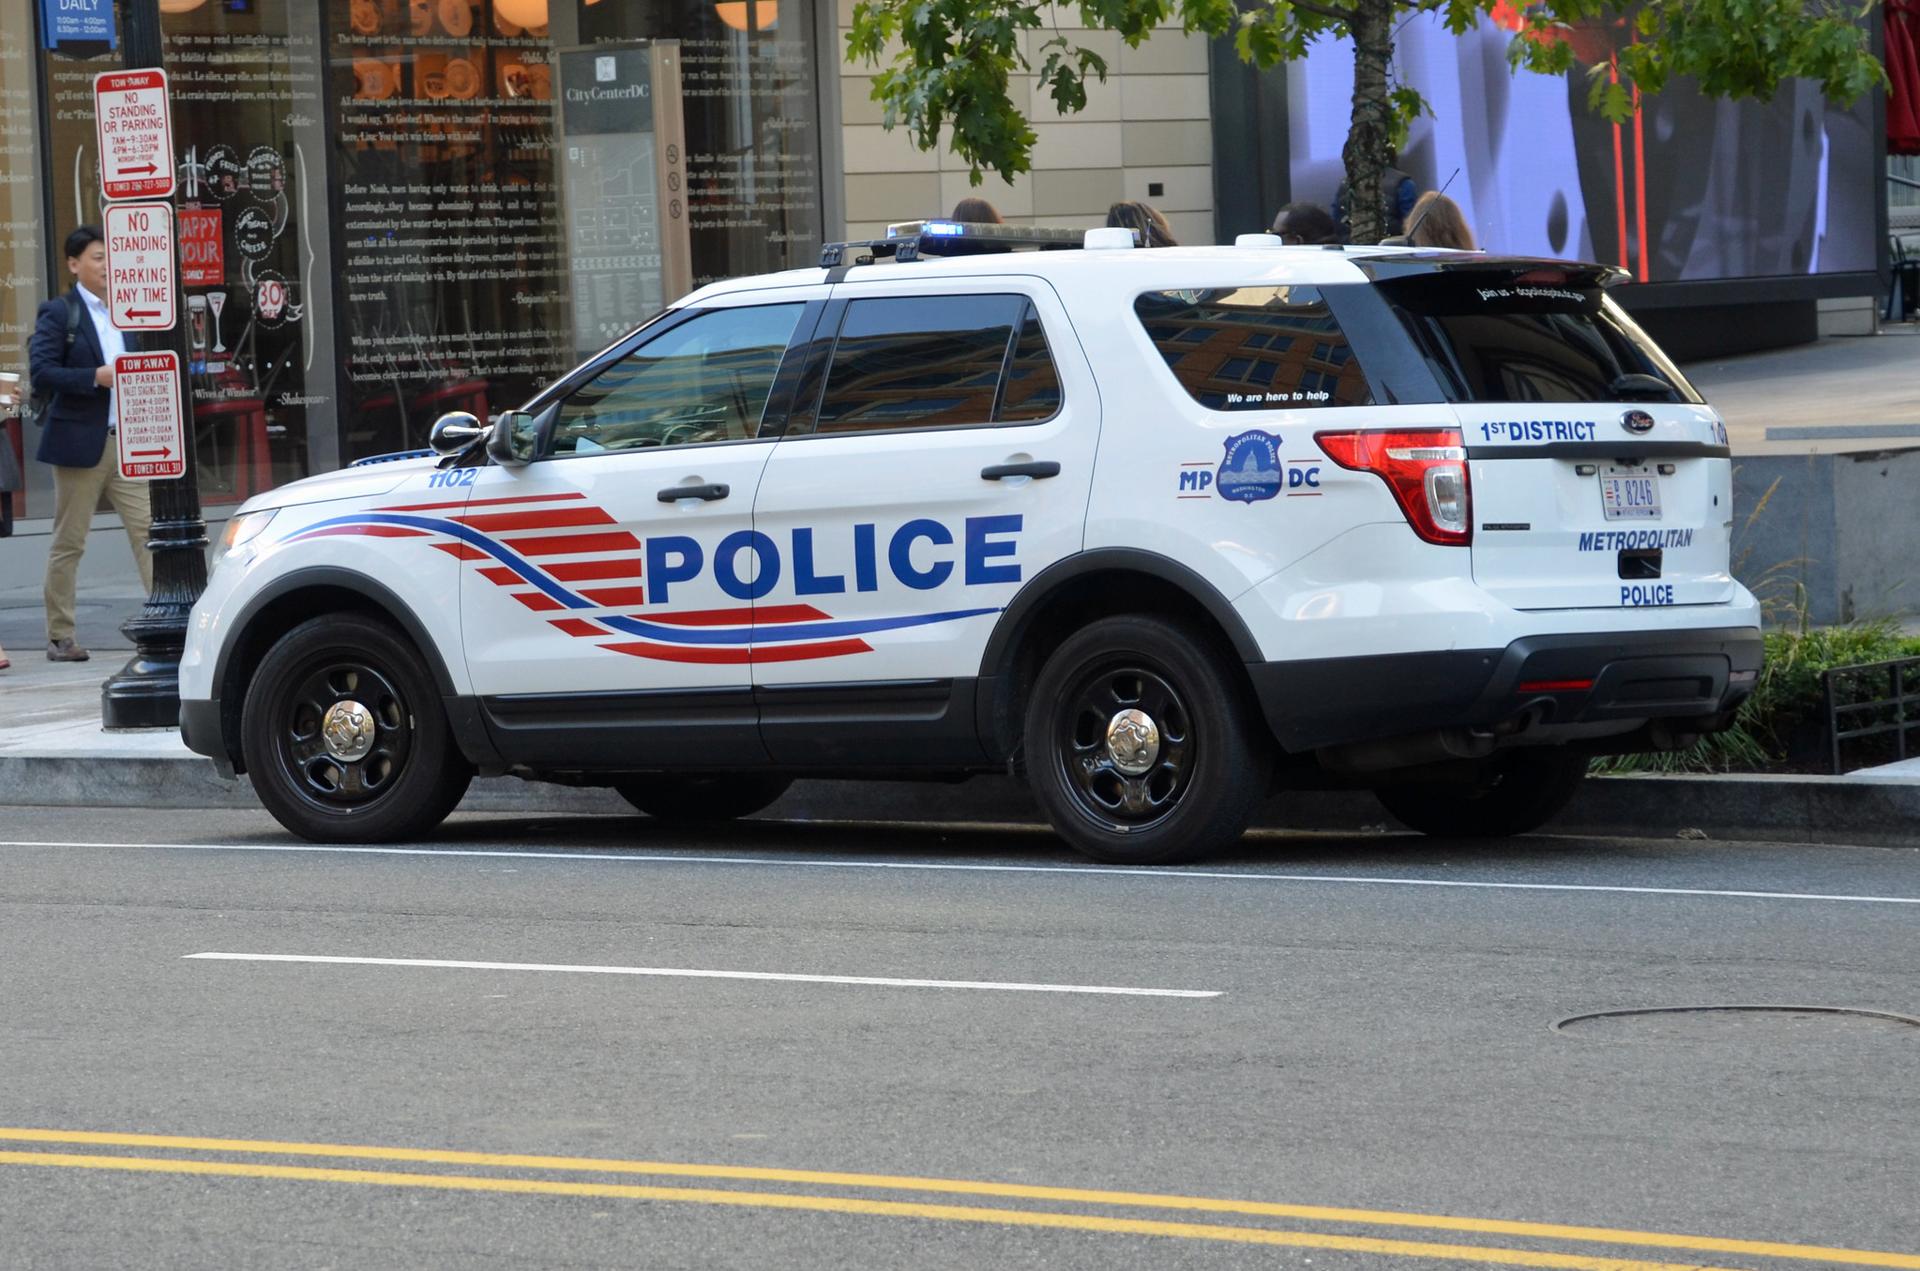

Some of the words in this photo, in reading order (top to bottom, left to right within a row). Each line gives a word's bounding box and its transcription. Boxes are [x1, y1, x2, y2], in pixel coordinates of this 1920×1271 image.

[60, 0, 100, 11] DAILY
[110, 79, 126, 88] TOW
[124, 92, 138, 104] NO
[566, 84, 649, 106] CityCenterDC
[109, 104, 156, 119] STANDING
[104, 121, 117, 133] OR
[122, 118, 163, 131] PARKING
[128, 212, 148, 232] NO
[112, 235, 167, 252] STANDING
[114, 267, 167, 284] PARKING
[116, 288, 138, 303] ANY
[143, 287, 167, 302] TIME
[1497, 289, 1510, 297] us
[122, 359, 141, 370] TOW
[144, 357, 170, 369] AWAY
[121, 375, 132, 385] NO
[136, 373, 169, 384] PARKING
[1227, 393, 1242, 403] We
[1246, 394, 1262, 402] are
[1266, 392, 1289, 401] here
[1292, 392, 1303, 400] to
[1306, 390, 1329, 402] help
[125, 415, 172, 424] MONDAY-FRIDAY
[1509, 421, 1595, 441] DISTRICT
[1226, 434, 1266, 465] METROPOLITAN
[1265, 440, 1276, 465] POLICE
[126, 464, 132, 474] IF
[134, 463, 154, 474] TOWED
[155, 463, 171, 473] CALL
[429, 468, 477, 488] 1102
[1179, 471, 1213, 491] MP
[1288, 467, 1320, 488] DC
[1625, 479, 1653, 506] 8246
[1578, 528, 1693, 551] METROPOLITAN
[646, 514, 1023, 604] POLICE
[1621, 585, 1674, 605] POLICE
